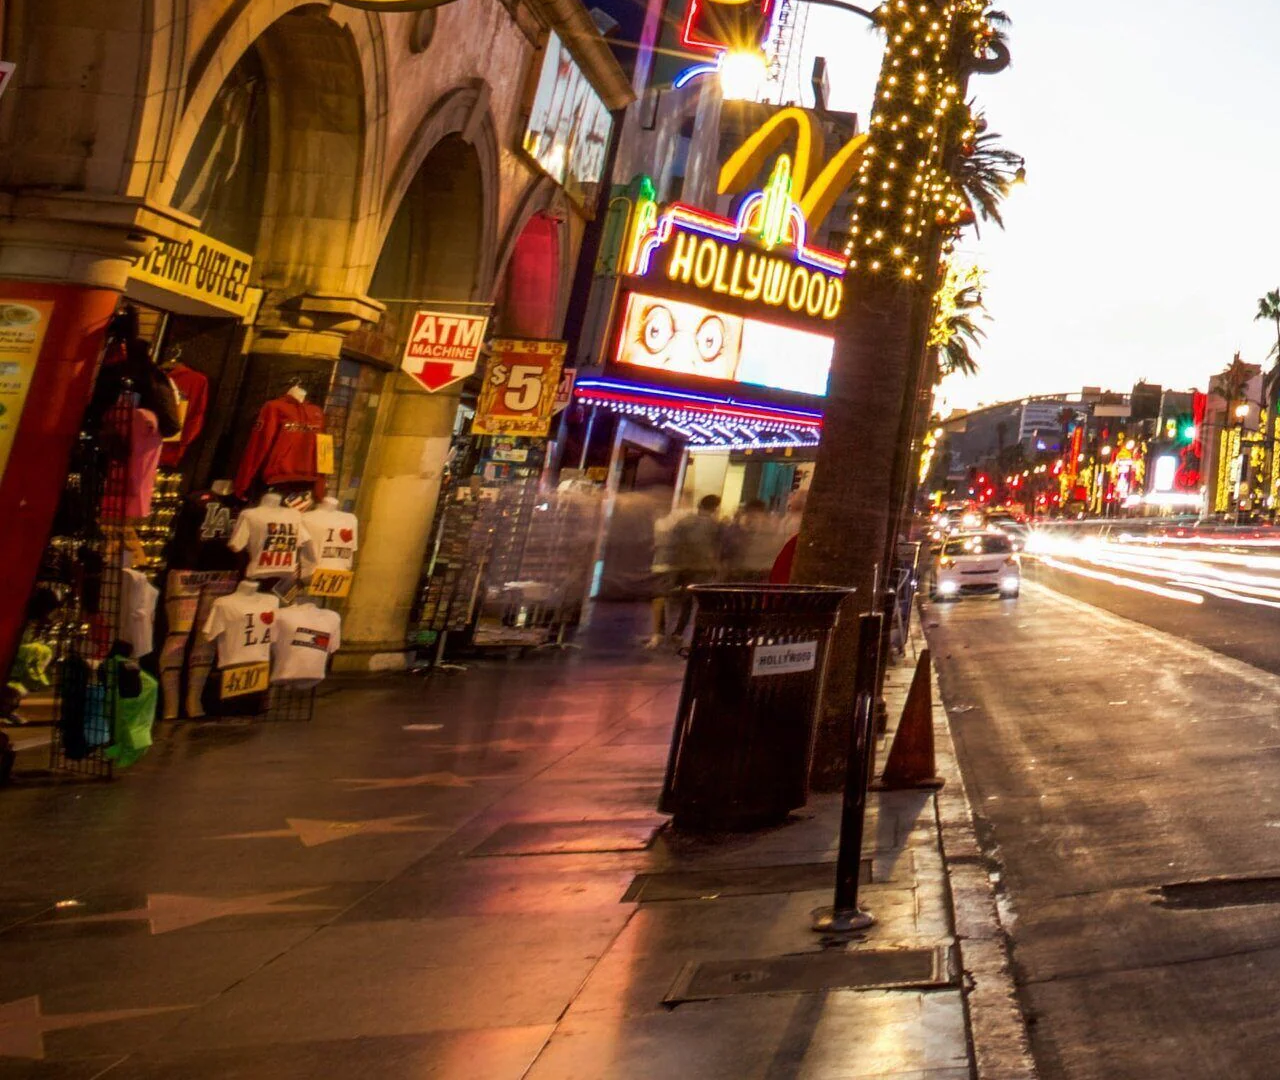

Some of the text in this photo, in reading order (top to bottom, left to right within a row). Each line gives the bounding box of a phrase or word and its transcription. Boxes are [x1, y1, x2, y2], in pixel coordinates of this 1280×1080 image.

[131, 238, 249, 304] VENIR OUTLET
[669, 230, 844, 320] HOLLYWOOD
[412, 316, 484, 347] ATM
[410, 344, 475, 360] MACHINE
[489, 364, 544, 412] $5
[325, 528, 335, 543] I
[258, 551, 293, 567] NIA
[244, 613, 255, 629] I
[758, 651, 812, 666] HOLLYWOOD
